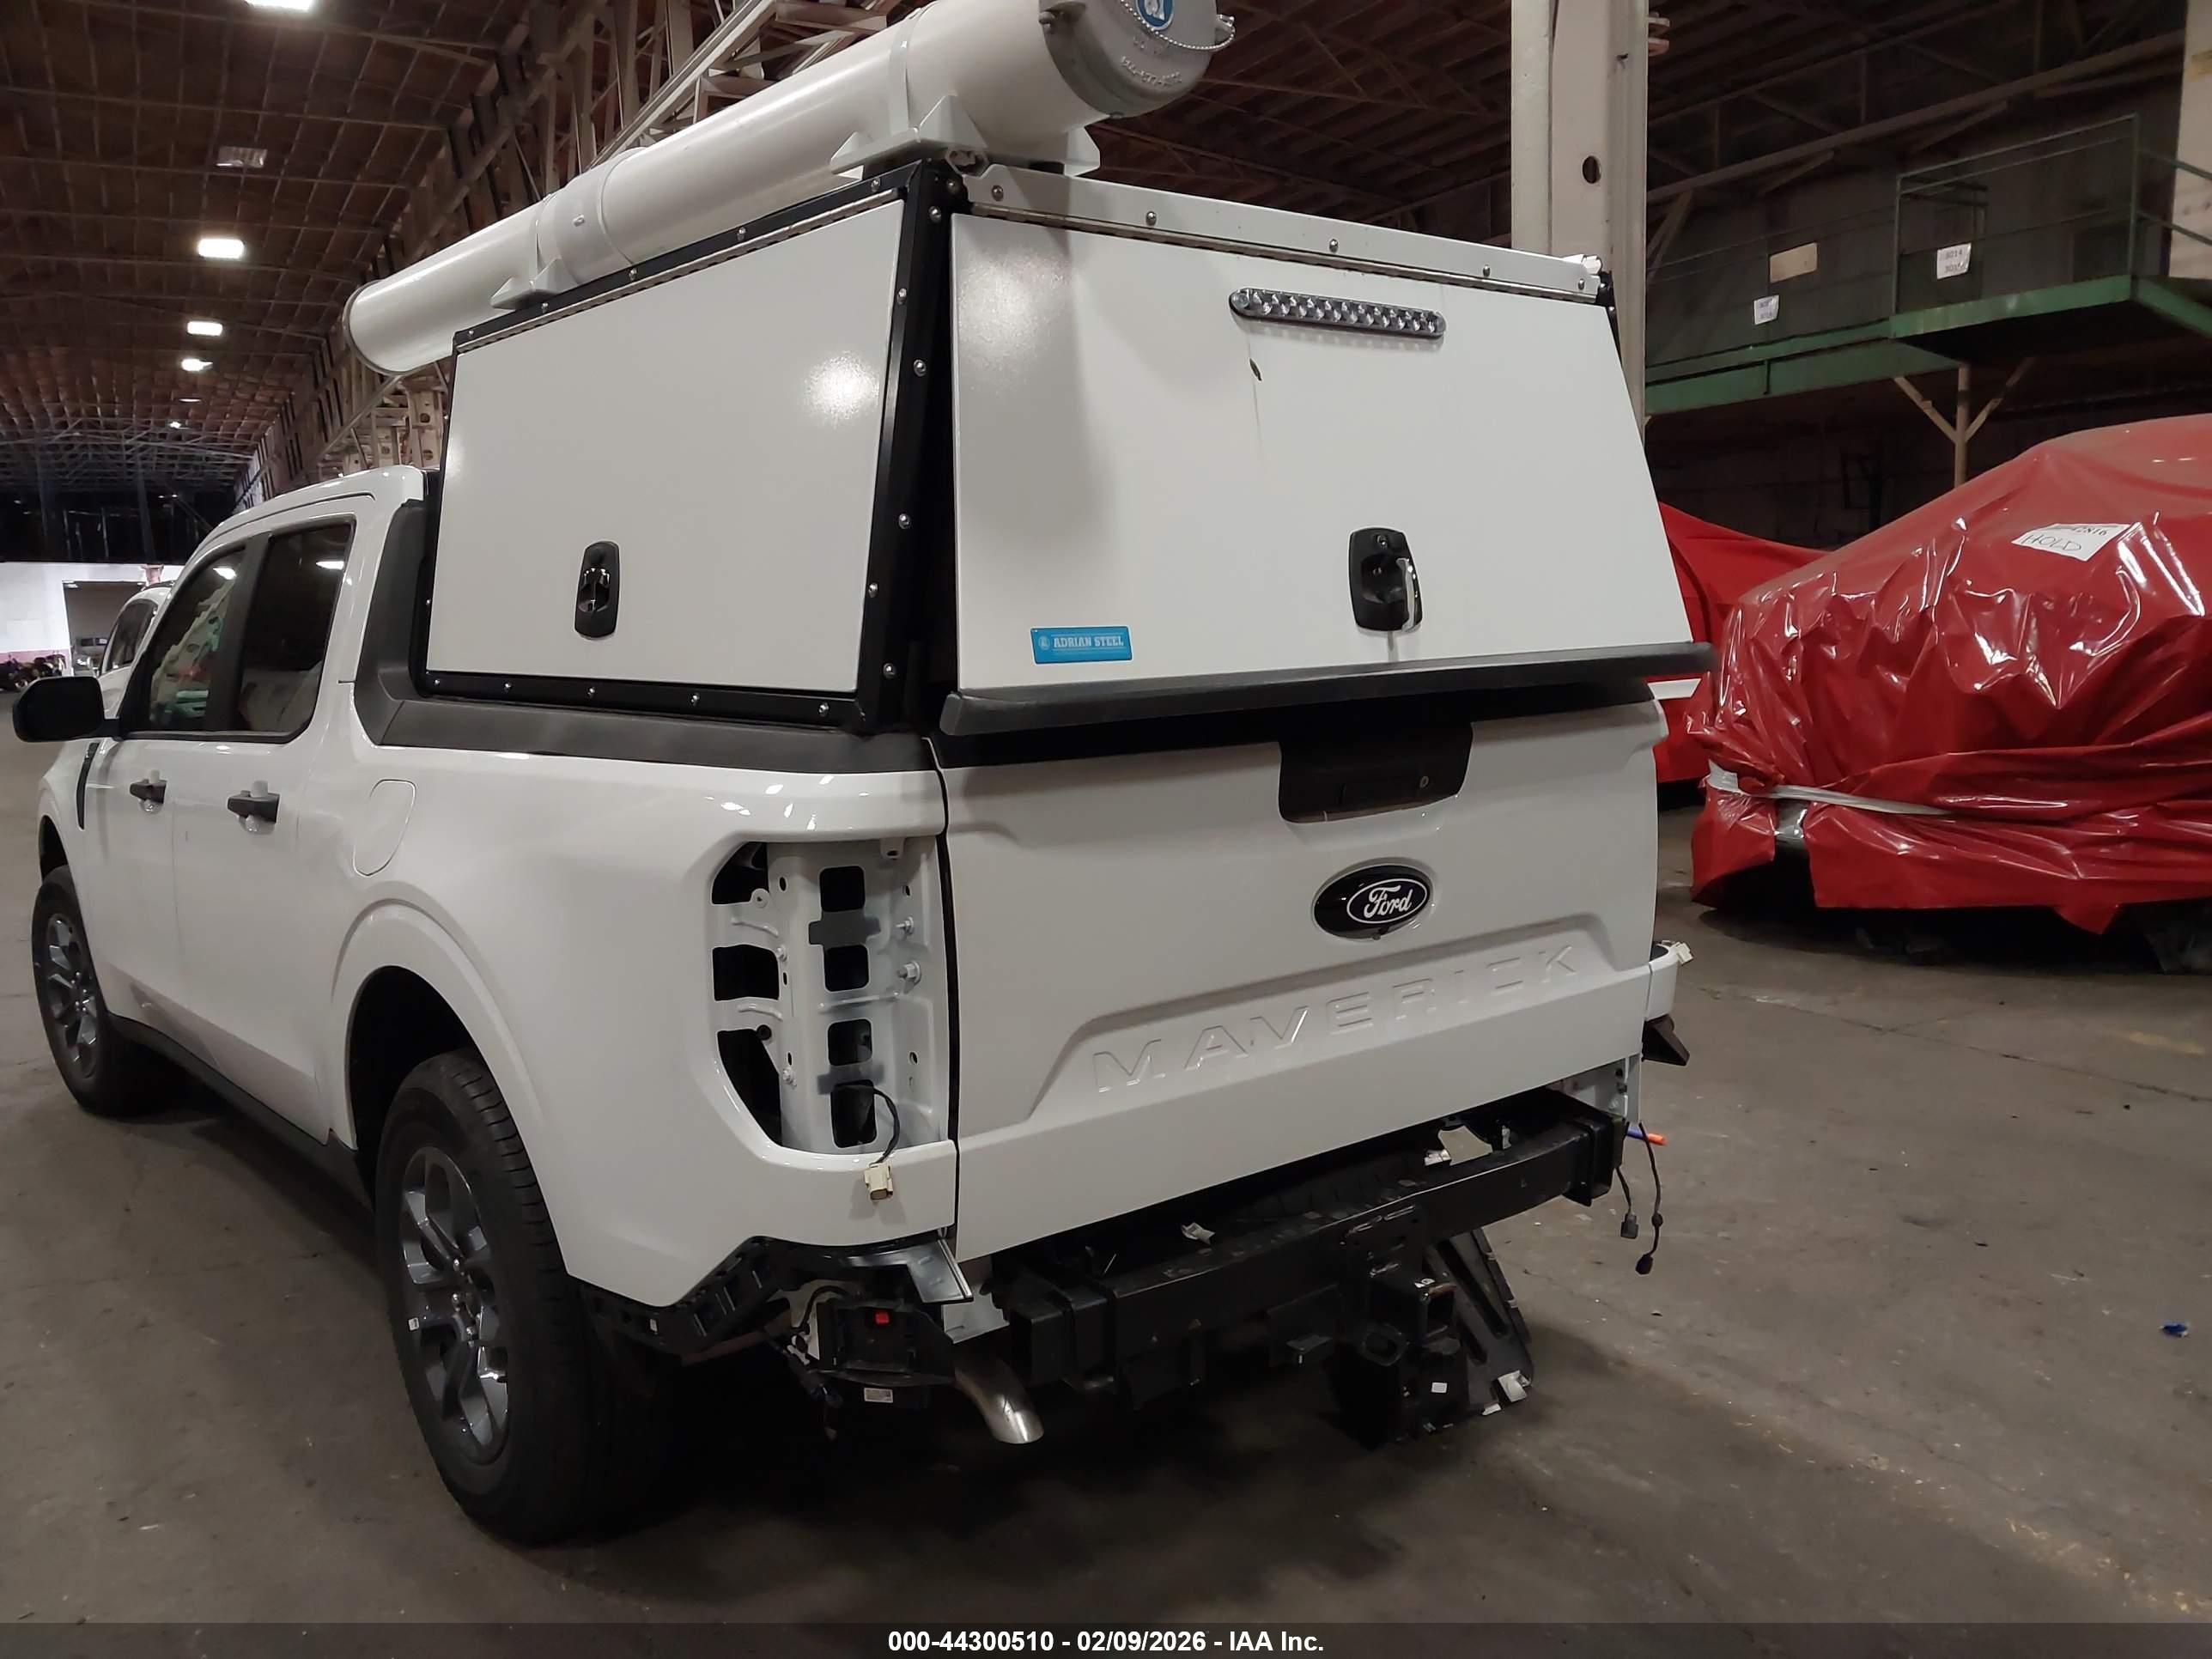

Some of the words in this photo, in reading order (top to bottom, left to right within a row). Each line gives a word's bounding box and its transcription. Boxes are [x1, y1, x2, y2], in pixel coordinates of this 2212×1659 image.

[2021, 534, 2082, 551] HOLD
[1054, 636, 1091, 648] ADRIAN
[1094, 635, 1124, 647] STEEL
[1363, 884, 1413, 919] Ford
[1092, 945, 1577, 1093] MAVERICK
